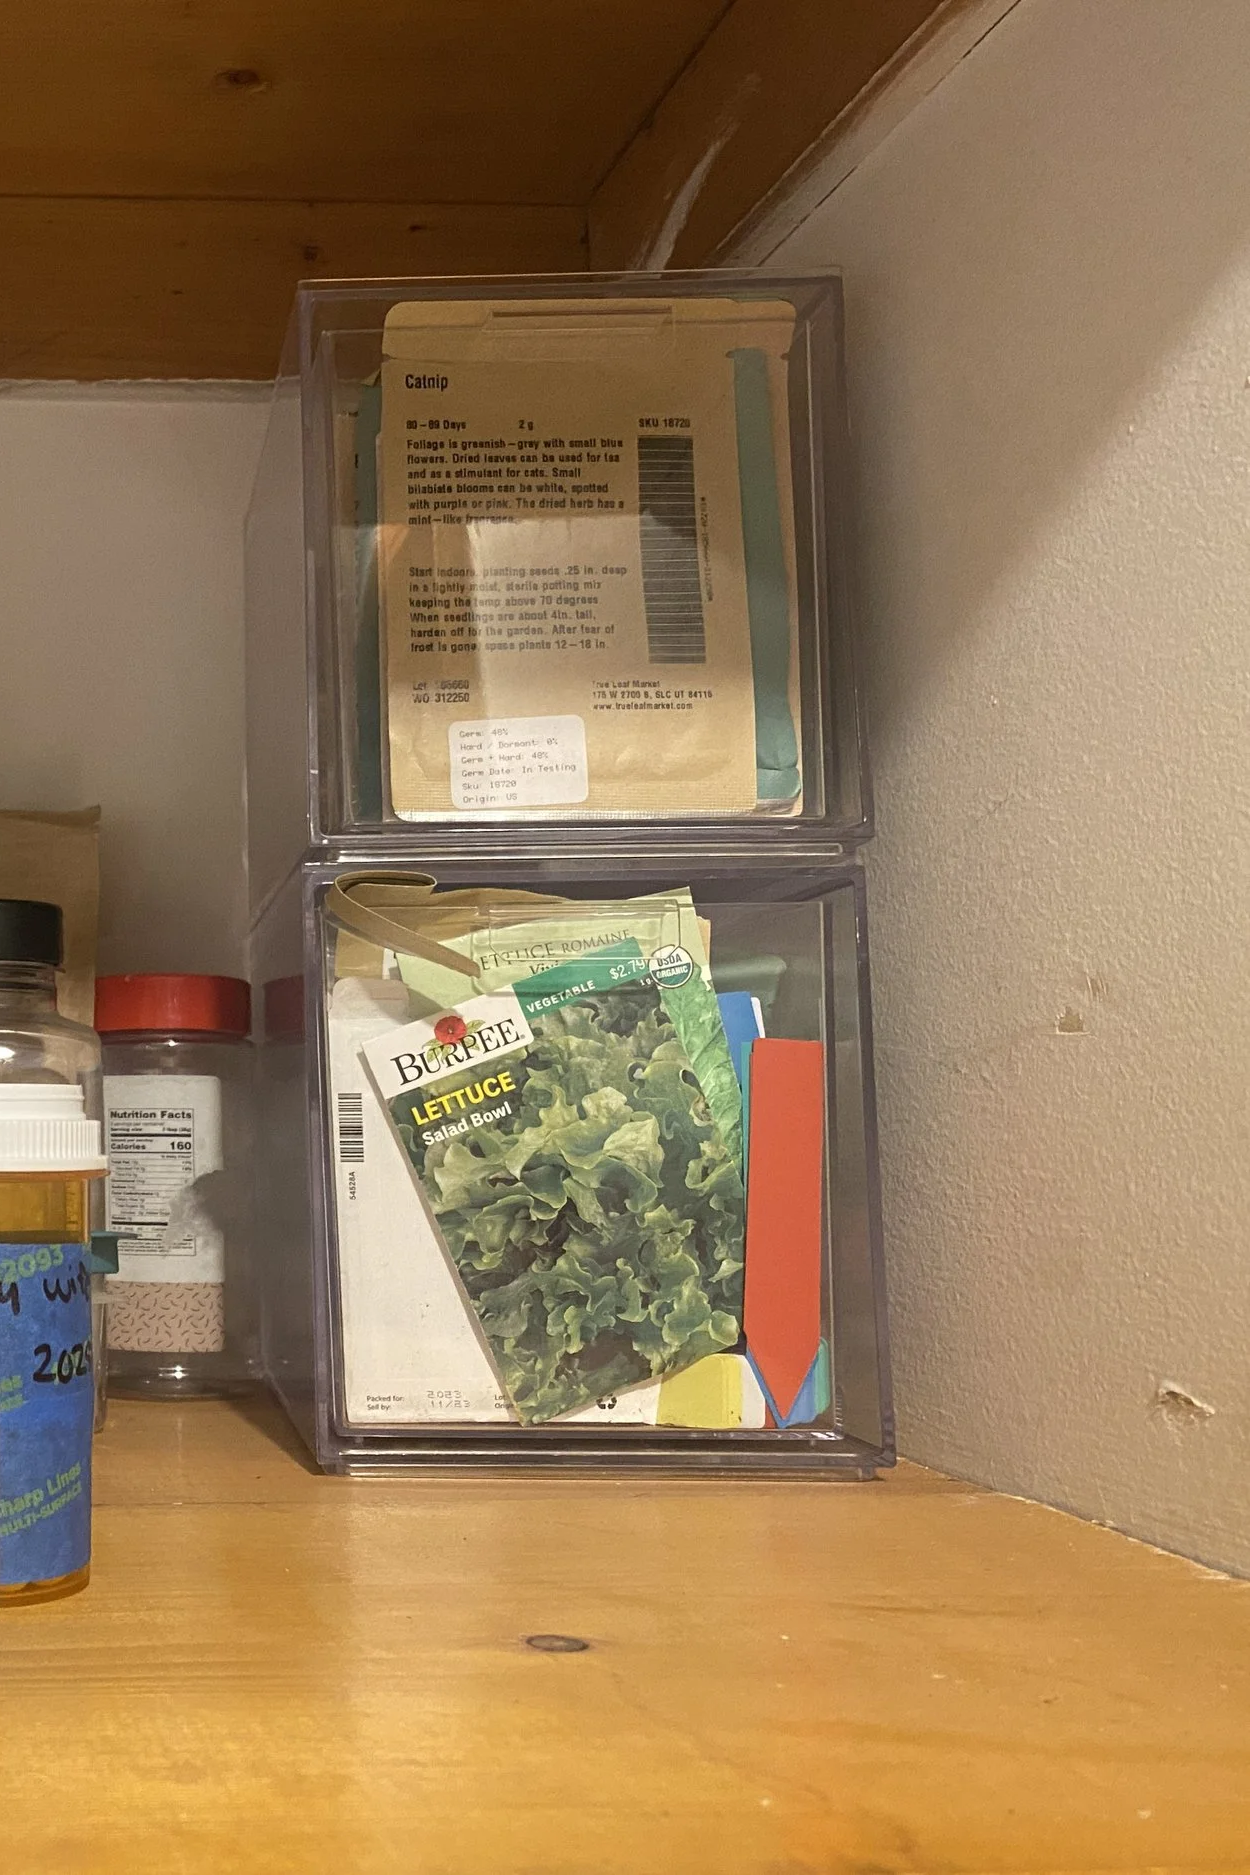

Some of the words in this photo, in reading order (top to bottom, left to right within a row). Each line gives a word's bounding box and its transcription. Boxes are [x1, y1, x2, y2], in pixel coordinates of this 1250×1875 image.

[405, 374, 449, 391] Catnip
[443, 420, 467, 431] Days
[518, 420, 525, 429] 2
[528, 422, 534, 431] g
[638, 418, 659, 428] SKU
[662, 418, 691, 428] 18720
[406, 439, 444, 449] Foliage
[448, 438, 458, 449] is
[543, 439, 564, 448] with
[569, 438, 596, 448] small
[600, 439, 623, 447] blue
[407, 455, 447, 464] flowers.
[452, 453, 480, 463] Dried
[520, 454, 537, 462] can
[542, 454, 554, 462] be
[558, 454, 582, 462] used
[586, 452, 600, 462] for
[604, 454, 619, 462] tea
[430, 470, 441, 478] as
[445, 470, 451, 478] a
[454, 469, 501, 478] stimulant
[506, 469, 519, 477] for
[552, 467, 580, 477] Small
[408, 484, 452, 493] bilabiate
[519, 484, 532, 492] be
[536, 483, 566, 492] white,
[571, 484, 608, 492] spotted
[409, 499, 429, 509] with
[433, 500, 467, 509] purple
[471, 500, 483, 508] or
[485, 500, 511, 508] pink.
[516, 498, 535, 508] The
[538, 498, 565, 508] dried
[570, 499, 593, 508] herb
[597, 500, 614, 508] has
[618, 500, 624, 508] a
[409, 567, 432, 576] Start
[482, 568, 525, 576] planting
[409, 584, 419, 592] in
[422, 583, 430, 591] a
[432, 581, 465, 593] lightly
[505, 581, 539, 590] sterile
[542, 581, 579, 590] potting
[583, 581, 601, 589] mix
[409, 599, 450, 608] keeping
[454, 597, 471, 607] the
[505, 598, 535, 606] above
[539, 596, 552, 606] 70
[410, 613, 439, 622] When
[444, 613, 493, 622] seedlings
[497, 613, 514, 621] are
[518, 612, 547, 620] about
[410, 629, 445, 637] harden
[450, 627, 464, 636] off
[467, 627, 480, 636] for
[485, 626, 502, 635] the
[552, 624, 576, 634] After
[580, 626, 599, 634] fear
[604, 624, 614, 633] of
[411, 643, 433, 651] frost
[438, 641, 447, 651] is
[518, 641, 551, 649] plants
[612, 680, 630, 688] Leaf
[632, 680, 660, 688] Market
[411, 692, 430, 704] WO
[435, 692, 470, 703] 312250
[609, 691, 618, 699] W
[620, 690, 641, 699] 2700
[655, 690, 672, 699] SLC
[674, 690, 685, 699] UT
[460, 742, 483, 751] Hard
[546, 737, 558, 746] 0%
[461, 755, 484, 764] Germ
[498, 753, 524, 762] Hard:
[461, 768, 484, 777] Germ
[522, 765, 532, 774] In
[538, 763, 577, 774] Testing
[490, 780, 517, 789] 18720
[506, 792, 518, 801] US
[480, 943, 556, 972] ETTUCE
[561, 929, 631, 954] ROMAINE
[656, 955, 682, 968] USDA
[609, 959, 647, 981] $2.79
[656, 965, 689, 980] ORGANIC
[526, 980, 596, 1014] VEGETABLE
[389, 1018, 520, 1086] BURPEE
[411, 1071, 517, 1126] LETTUCE
[110, 1111, 157, 1119] Nutrition
[160, 1111, 192, 1119] Facts
[422, 1118, 470, 1146] Salad
[470, 1101, 512, 1128] Bowl
[170, 1142, 191, 1150] 160
[348, 1171, 357, 1200] 54528A
[426, 1390, 462, 1399] 2023
[430, 1400, 470, 1409] 11/23
[46, 1460, 81, 1496] Lines
